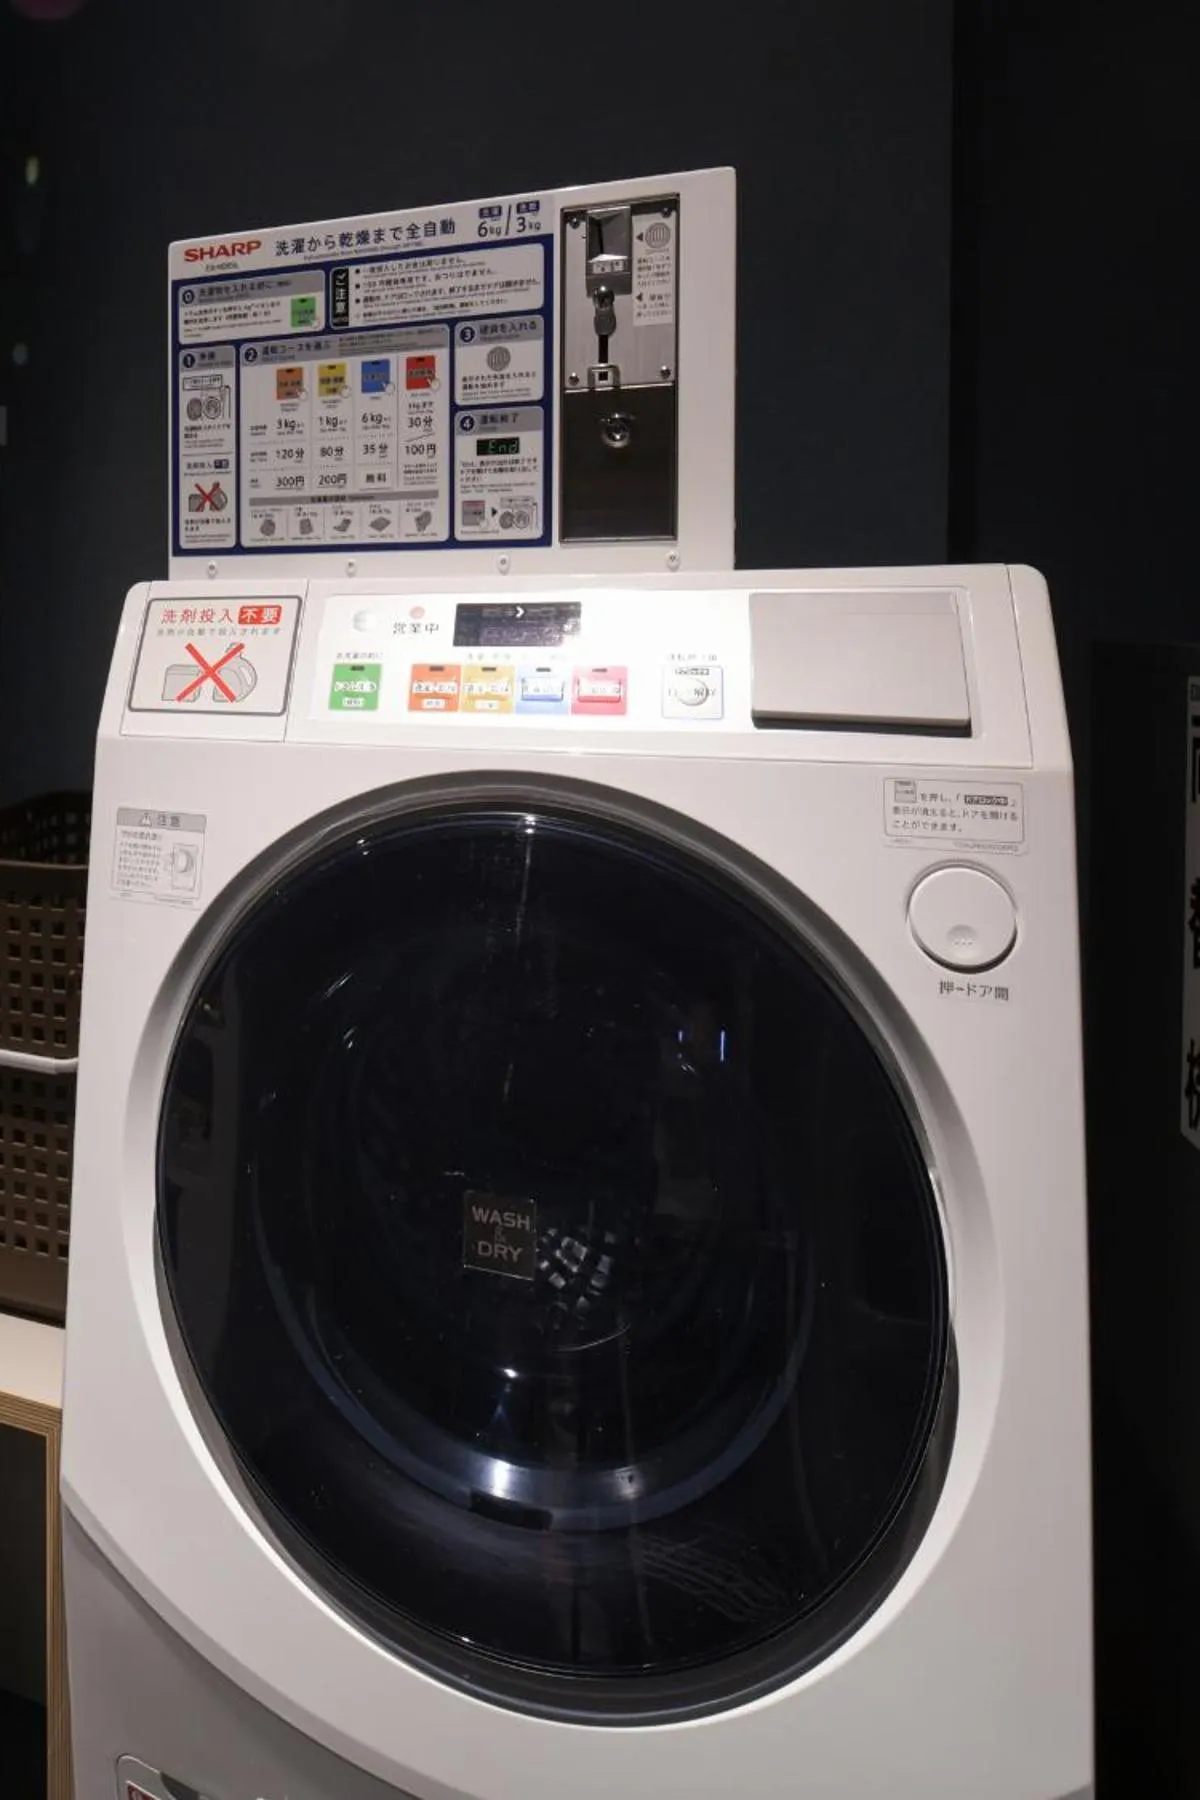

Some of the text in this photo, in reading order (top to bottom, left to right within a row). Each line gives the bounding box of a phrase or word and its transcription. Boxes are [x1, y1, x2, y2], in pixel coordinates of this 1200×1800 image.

[275, 217, 456, 257] 洗濯から乾燥まで全自動
[184, 240, 262, 263] SHARP
[487, 439, 519, 455] End
[161, 606, 279, 624] 洗剤投入 不要
[471, 1205, 531, 1231] WASH
[477, 1240, 523, 1263] DRY
